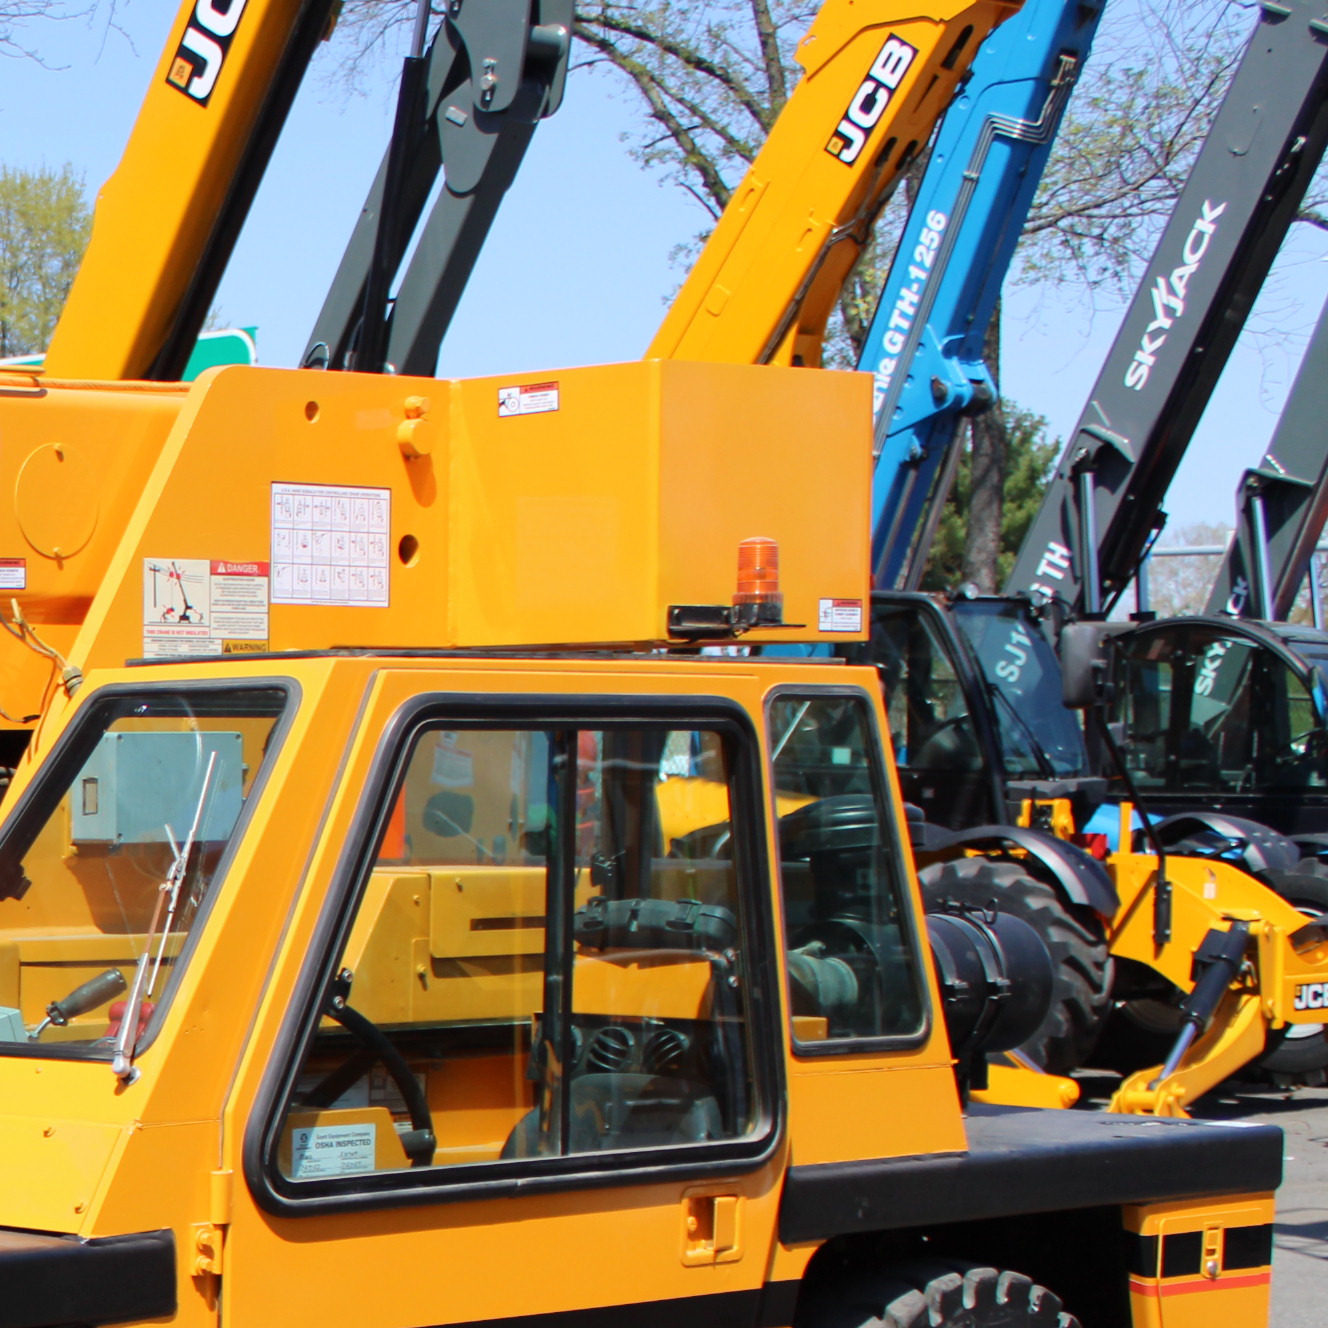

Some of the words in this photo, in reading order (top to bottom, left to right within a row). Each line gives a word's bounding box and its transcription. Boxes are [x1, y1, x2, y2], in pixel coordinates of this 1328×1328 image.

[182, 0, 248, 99] JC
[837, 38, 915, 164] JCB
[882, 209, 947, 356] GTH-1256
[1123, 199, 1228, 391] SKYJACK
[227, 564, 259, 573] DANGER
[1035, 541, 1072, 580] TH
[232, 642, 267, 651] WARNING
[1294, 983, 1328, 1010] JC
[315, 1141, 334, 1149] OSHA
[335, 1138, 371, 1148] INSPECTED
